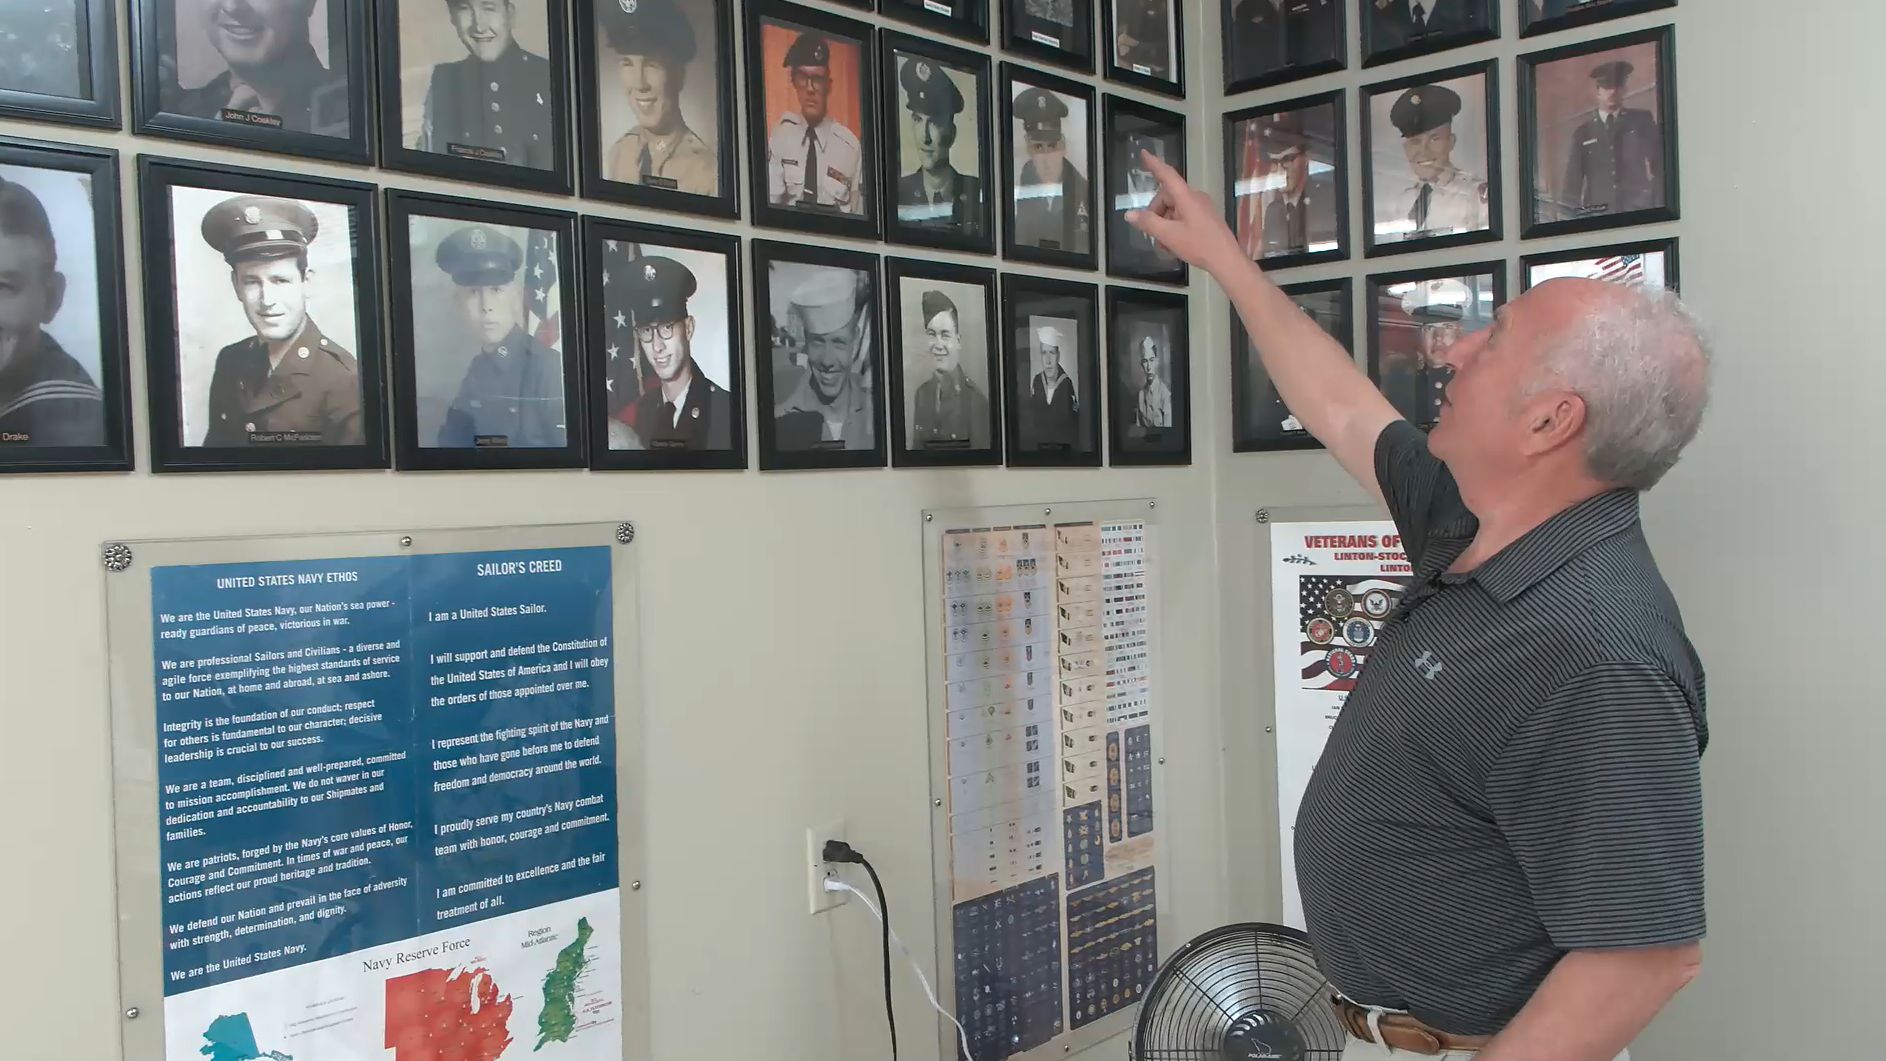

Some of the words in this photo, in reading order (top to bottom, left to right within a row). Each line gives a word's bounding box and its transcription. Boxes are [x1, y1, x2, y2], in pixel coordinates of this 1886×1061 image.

[225, 112, 244, 120] John
[2, 432, 29, 440] Drake
[250, 434, 275, 442] Robert
[276, 434, 282, 442] C
[1304, 534, 1377, 548] VETERANS
[1381, 534, 1400, 548] OF
[477, 561, 525, 575] SAILOR'S
[528, 559, 561, 572] CREED
[1334, 552, 1408, 560] LINTON-STOC
[216, 576, 255, 588] UNITED
[257, 574, 294, 586] STATES
[297, 573, 323, 583] NAVY
[325, 571, 357, 582] ETHOS
[160, 614, 175, 622] We
[195, 611, 210, 620] the
[213, 609, 242, 619] United
[244, 608, 272, 616] States
[273, 606, 297, 615] Navy,
[315, 602, 348, 611] Nation's
[366, 600, 389, 610] power
[428, 612, 432, 621] I
[435, 612, 448, 620] am
[460, 607, 488, 618] United
[491, 606, 516, 616] States
[520, 603, 546, 614] Sailor.
[160, 628, 187, 638] ready
[189, 625, 234, 638] guardians
[237, 623, 245, 632] of
[248, 623, 277, 633] peace,
[279, 618, 320, 629] victorious
[430, 654, 434, 663] I
[436, 652, 452, 663] will
[454, 649, 488, 662] support
[490, 647, 505, 658] and
[507, 644, 535, 656] defend
[536, 643, 550, 652] the
[552, 638, 597, 651] Constitution
[599, 637, 606, 646] of
[430, 675, 444, 685] the
[446, 670, 476, 683] United
[478, 669, 505, 679] States
[507, 666, 516, 676] of
[517, 663, 551, 675] America
[552, 660, 567, 671] and
[569, 660, 572, 668] I
[574, 658, 588, 668] will
[590, 657, 608, 667] obey
[430, 696, 445, 706] the
[447, 693, 476, 704] orders
[478, 690, 487, 700] of
[489, 689, 512, 699] those
[514, 682, 554, 697] appointed
[556, 682, 573, 690] over
[431, 739, 434, 748] I
[437, 734, 478, 748] represent
[480, 732, 492, 741] the
[496, 727, 526, 740] fighting
[528, 723, 548, 735] spirit
[550, 721, 558, 731] of
[560, 720, 572, 729] the
[574, 718, 592, 728] Navy
[595, 714, 608, 724] and
[164, 748, 213, 762] leadership
[216, 747, 224, 756] is
[226, 742, 257, 754] crucial
[259, 742, 268, 750] to
[287, 736, 323, 746] success.
[433, 759, 456, 770] those
[459, 755, 476, 765] who
[479, 753, 498, 762] have
[500, 749, 520, 761] gone
[522, 745, 548, 755] before
[550, 743, 562, 751] me
[564, 740, 572, 749] to
[574, 735, 599, 747] defend
[434, 778, 469, 791] freedom
[471, 773, 486, 785] and
[489, 767, 533, 782] democracy
[535, 761, 562, 774] around
[564, 759, 576, 769] the
[578, 754, 601, 766] world.
[434, 824, 437, 834] I
[440, 818, 473, 835] proudly
[476, 815, 498, 826] serve
[501, 812, 513, 822] my
[516, 804, 552, 818] country's
[554, 800, 573, 810] Navy
[575, 794, 603, 806] combat
[166, 827, 206, 840] families.
[435, 844, 456, 855] team
[460, 838, 477, 850] with
[480, 834, 507, 846] honor,
[510, 827, 542, 840] courage
[544, 821, 558, 833] and
[561, 812, 609, 830] commitment.
[168, 890, 201, 902] actions
[205, 882, 233, 895] reflect
[236, 880, 250, 889] our
[253, 873, 277, 888] proud
[281, 868, 315, 880] heritage
[318, 863, 333, 873] and
[335, 857, 371, 870] tradition.
[436, 888, 440, 898] I
[442, 887, 455, 897] am
[458, 874, 502, 893] committed
[505, 874, 513, 882] to
[516, 864, 559, 880] excellence
[561, 858, 575, 870] and
[577, 856, 590, 866] the
[592, 852, 604, 862] fair
[437, 901, 477, 919] treatment
[480, 898, 487, 909] of
[491, 895, 504, 906] all.
[169, 938, 189, 949] with
[192, 929, 232, 944] strength,
[234, 916, 297, 935] determination,
[298, 910, 314, 921] and
[316, 905, 347, 918] dignity.
[528, 926, 551, 937] Region
[171, 970, 185, 980] We
[189, 967, 203, 976] are
[206, 963, 219, 972] the
[223, 954, 251, 968] United
[254, 949, 280, 961] States
[284, 944, 306, 954] Navy.
[363, 957, 392, 972] Navy
[396, 946, 438, 964] Reserve
[442, 938, 470, 953] Force
